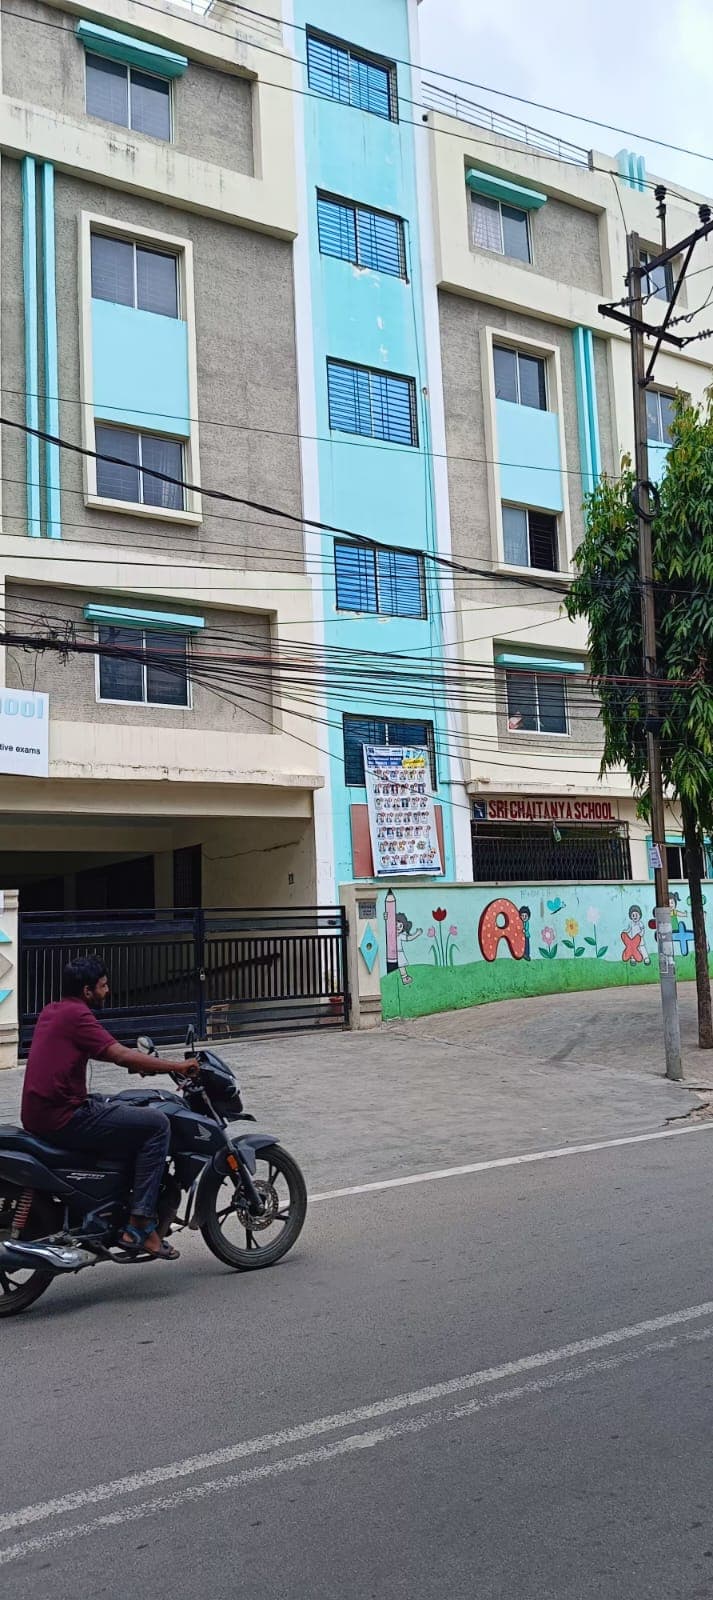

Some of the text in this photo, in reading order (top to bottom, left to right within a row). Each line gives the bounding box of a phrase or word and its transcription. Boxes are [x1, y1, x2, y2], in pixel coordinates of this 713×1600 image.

[0, 698, 44, 719] ool
[15, 746, 40, 755] exams
[488, 799, 615, 820] SRI CHAITANYA SCHOOL
